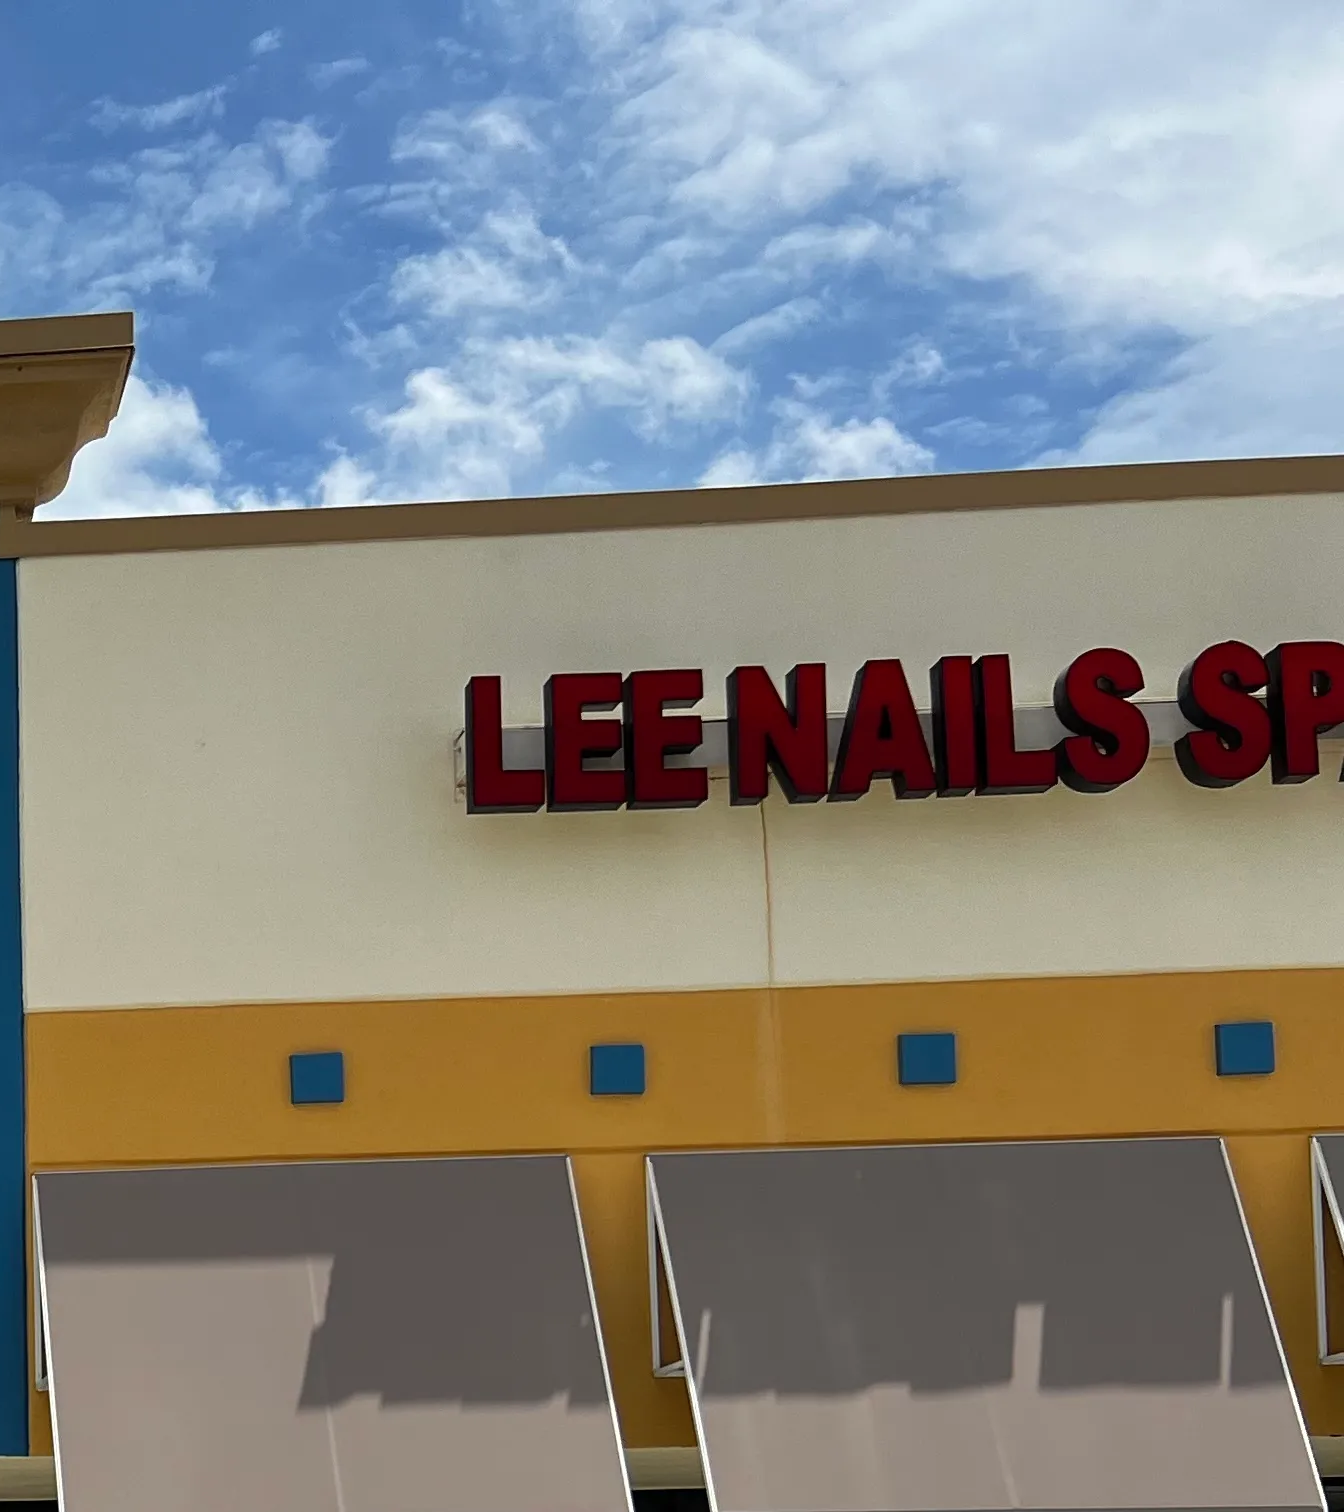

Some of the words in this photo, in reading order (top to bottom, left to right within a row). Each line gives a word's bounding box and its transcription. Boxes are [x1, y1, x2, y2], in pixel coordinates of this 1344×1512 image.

[465, 669, 709, 814] LEE
[727, 648, 1151, 806] NAILS
[1174, 640, 1344, 789] SP
